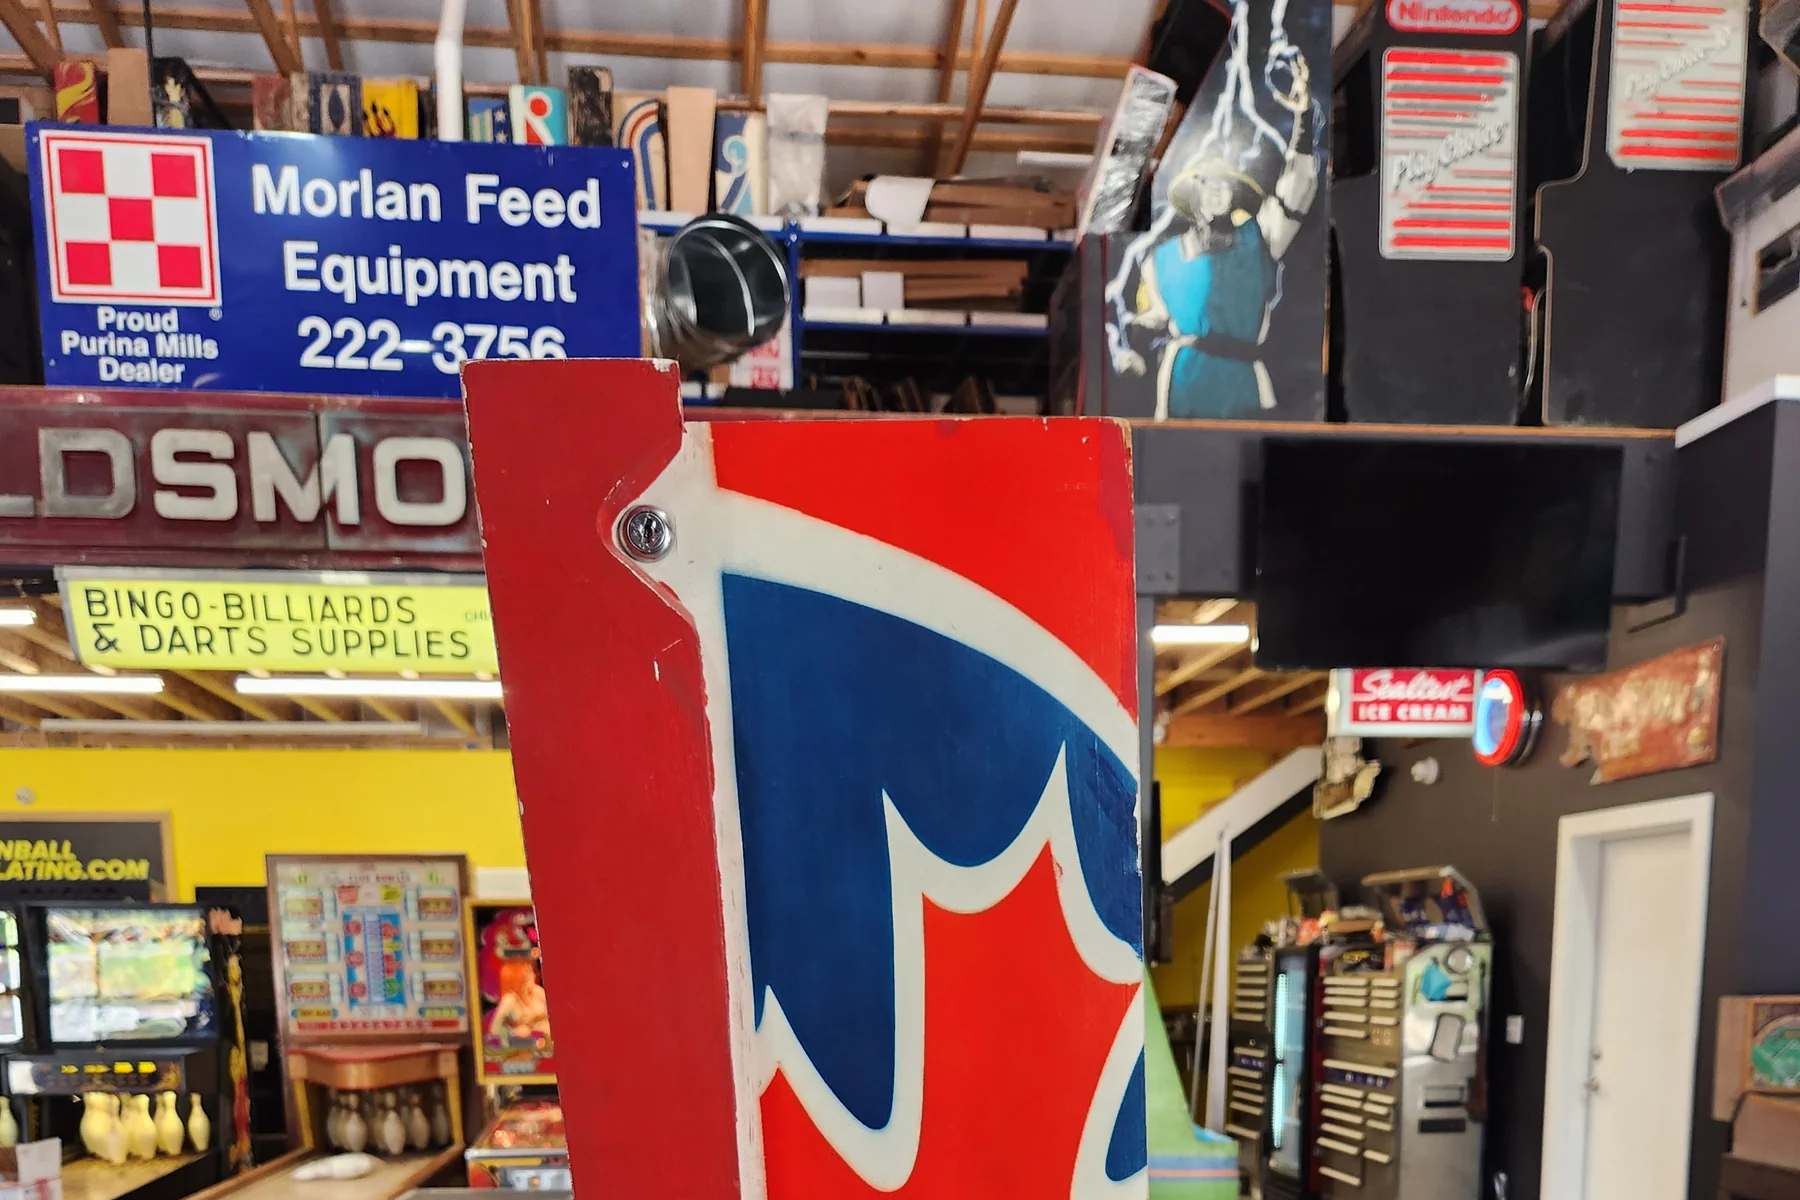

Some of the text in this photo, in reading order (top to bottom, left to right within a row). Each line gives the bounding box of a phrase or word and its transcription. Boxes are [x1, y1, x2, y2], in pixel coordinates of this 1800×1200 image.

[1398, 1, 1512, 24] Nintendo
[252, 163, 603, 230] Morlan Feed
[283, 241, 578, 307] Equipment
[97, 306, 179, 333] Proud
[61, 331, 219, 359] Purina Mills
[297, 316, 568, 372] 222-3756
[98, 357, 186, 384] Dealer
[84, 588, 416, 624] BINGO-BILLIARDS
[93, 622, 470, 659] & DARTS SUPPLIES
[1358, 668, 1473, 701] Sealtest
[1357, 703, 1468, 721] ICE CREAM
